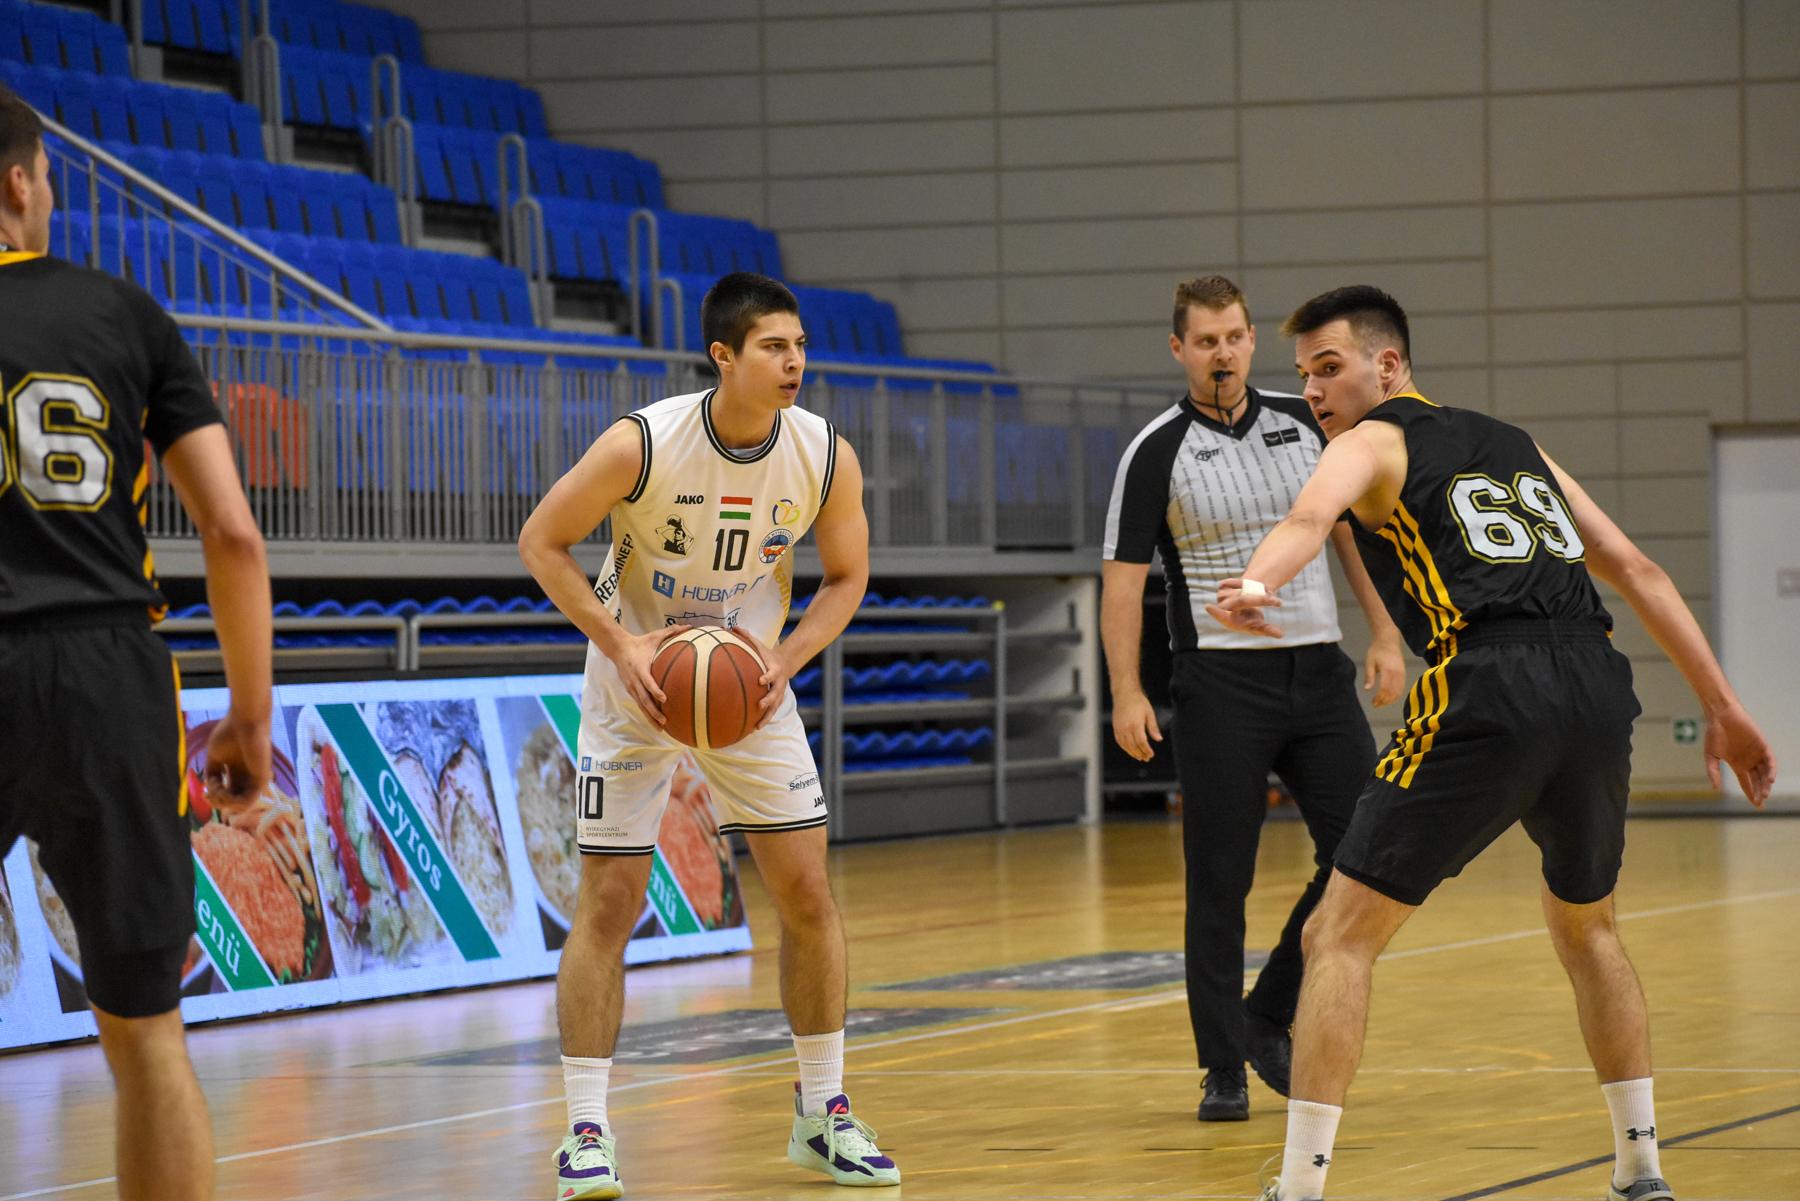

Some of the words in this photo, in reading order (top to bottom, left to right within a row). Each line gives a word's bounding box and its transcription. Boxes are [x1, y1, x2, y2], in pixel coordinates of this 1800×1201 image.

[0, 371, 114, 512] 6
[674, 494, 704, 505] JAKO
[1447, 471, 1585, 565] 69
[712, 528, 750, 571] 10
[682, 582, 747, 602] HÜBNR
[595, 760, 643, 771] HÜBNER
[578, 775, 604, 820] 10
[378, 769, 442, 891] Gyros
[194, 885, 240, 977] enü
